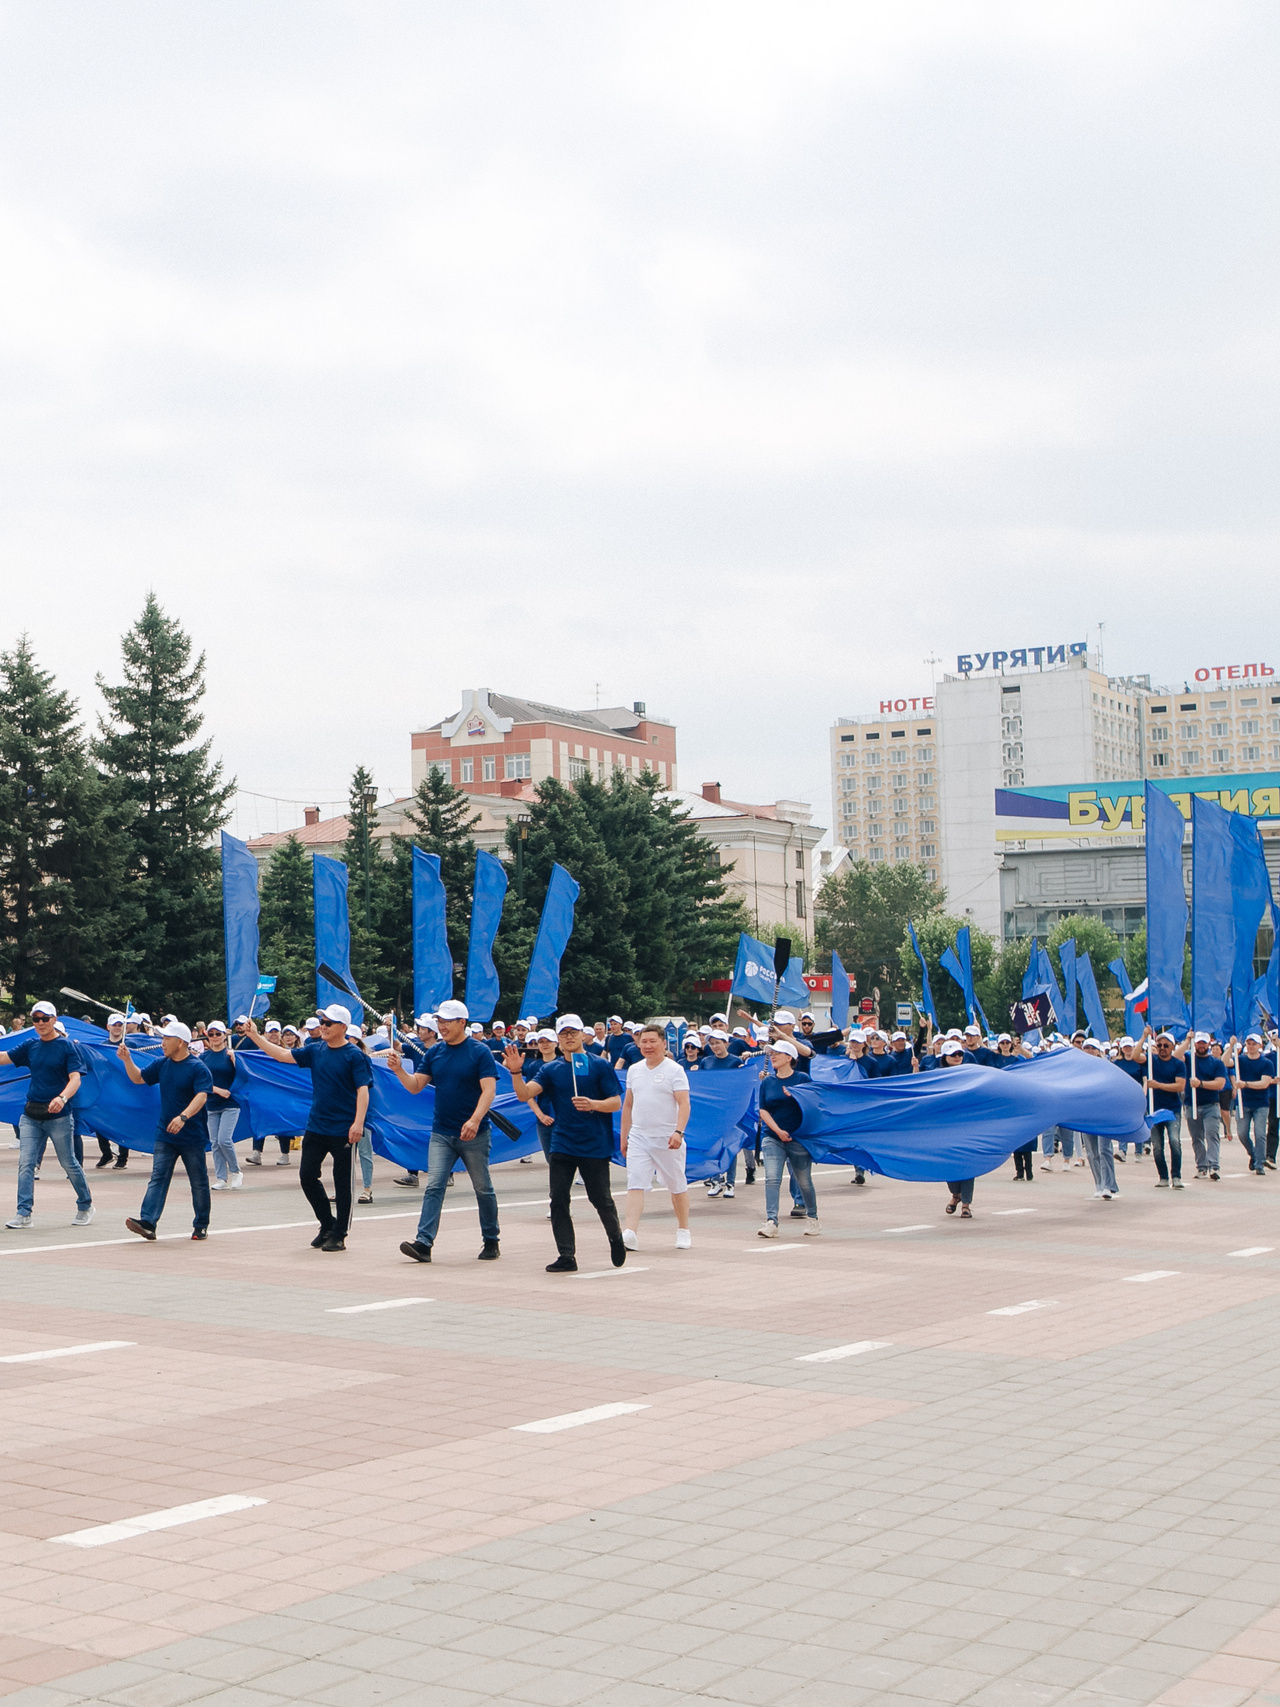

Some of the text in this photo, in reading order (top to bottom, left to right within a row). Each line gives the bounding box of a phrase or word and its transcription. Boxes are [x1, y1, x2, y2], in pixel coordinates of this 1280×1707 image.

[957, 642, 1087, 673] БУРЯТИЯ
[1194, 662, 1275, 681] ОТЕЛЬ
[879, 696, 936, 713] HOTE
